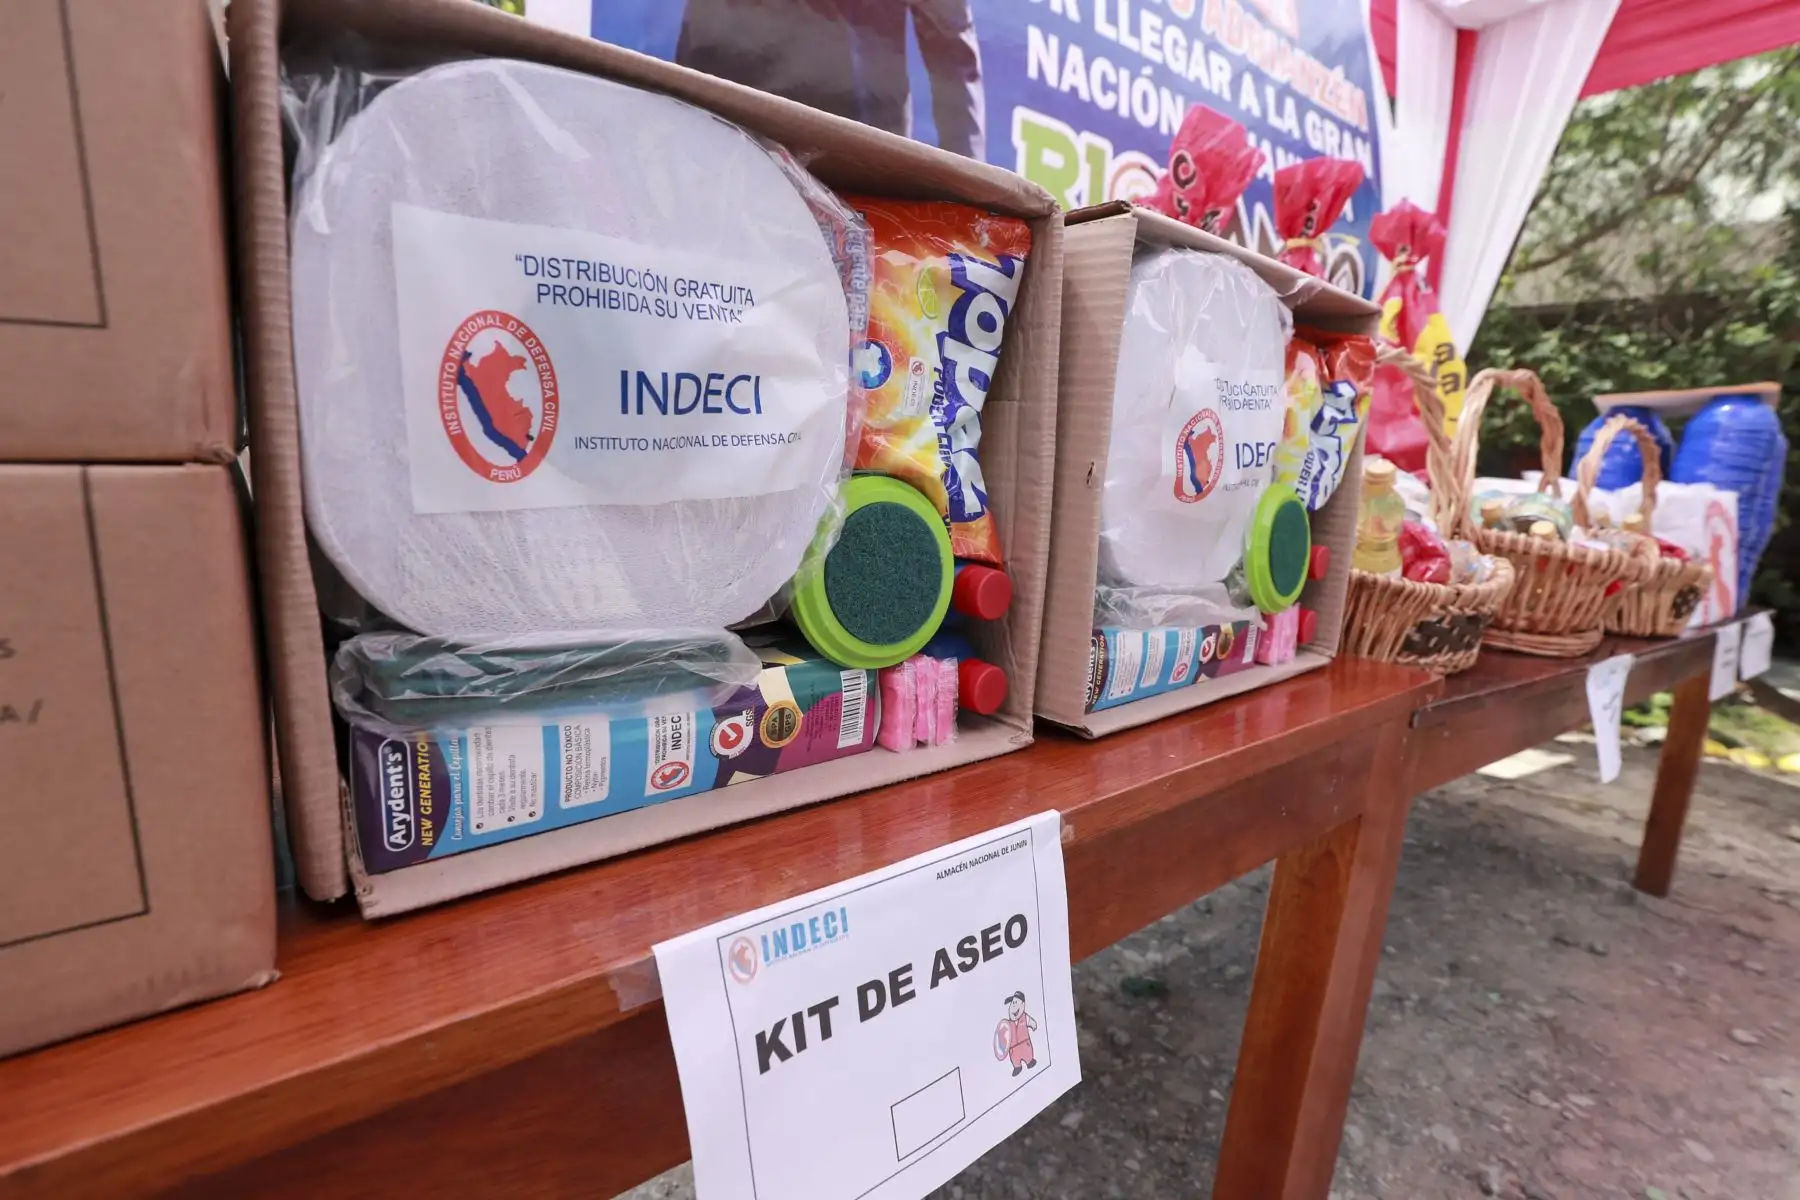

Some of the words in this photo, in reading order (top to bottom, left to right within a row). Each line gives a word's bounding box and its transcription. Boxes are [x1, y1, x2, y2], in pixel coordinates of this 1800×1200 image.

[1027, 24, 1185, 137] NACIÓN
[1094, 0, 1234, 101] LLEGAR
[1239, 72, 1261, 118] A
[1265, 85, 1300, 139] LA
[1304, 110, 1373, 179] GRAN
[515, 253, 668, 295] "DISTRIBUCIÓN
[673, 276, 755, 307] GRATUITA
[537, 283, 652, 316] PROHIBIDA
[654, 299, 678, 320] SU
[448, 314, 504, 360] NACIONAL
[506, 320, 528, 339] DE
[524, 336, 555, 398] DEFENSA
[442, 362, 460, 436] INSTITUTO
[620, 370, 763, 416] INDECI
[540, 401, 556, 433] CIVIL
[574, 435, 649, 451] INSTITUTO
[652, 434, 709, 451] NACIONAL
[712, 434, 729, 447] DE
[731, 432, 785, 447] DEFENSA
[489, 463, 521, 481] PERÚ
[1298, 450, 1315, 487] ODER
[416, 735, 433, 815] GENERATIO
[565, 754, 572, 764] NO
[387, 751, 410, 845] Arydent's
[421, 817, 434, 846] NEW
[935, 860, 969, 881] ALMACÉN
[969, 849, 1001, 869] NACIONAL
[1001, 845, 1010, 856] DE
[760, 906, 850, 964] INDECI
[755, 995, 840, 1076] KIT
[856, 962, 917, 1024] DE
[929, 913, 1029, 990] ASEO
